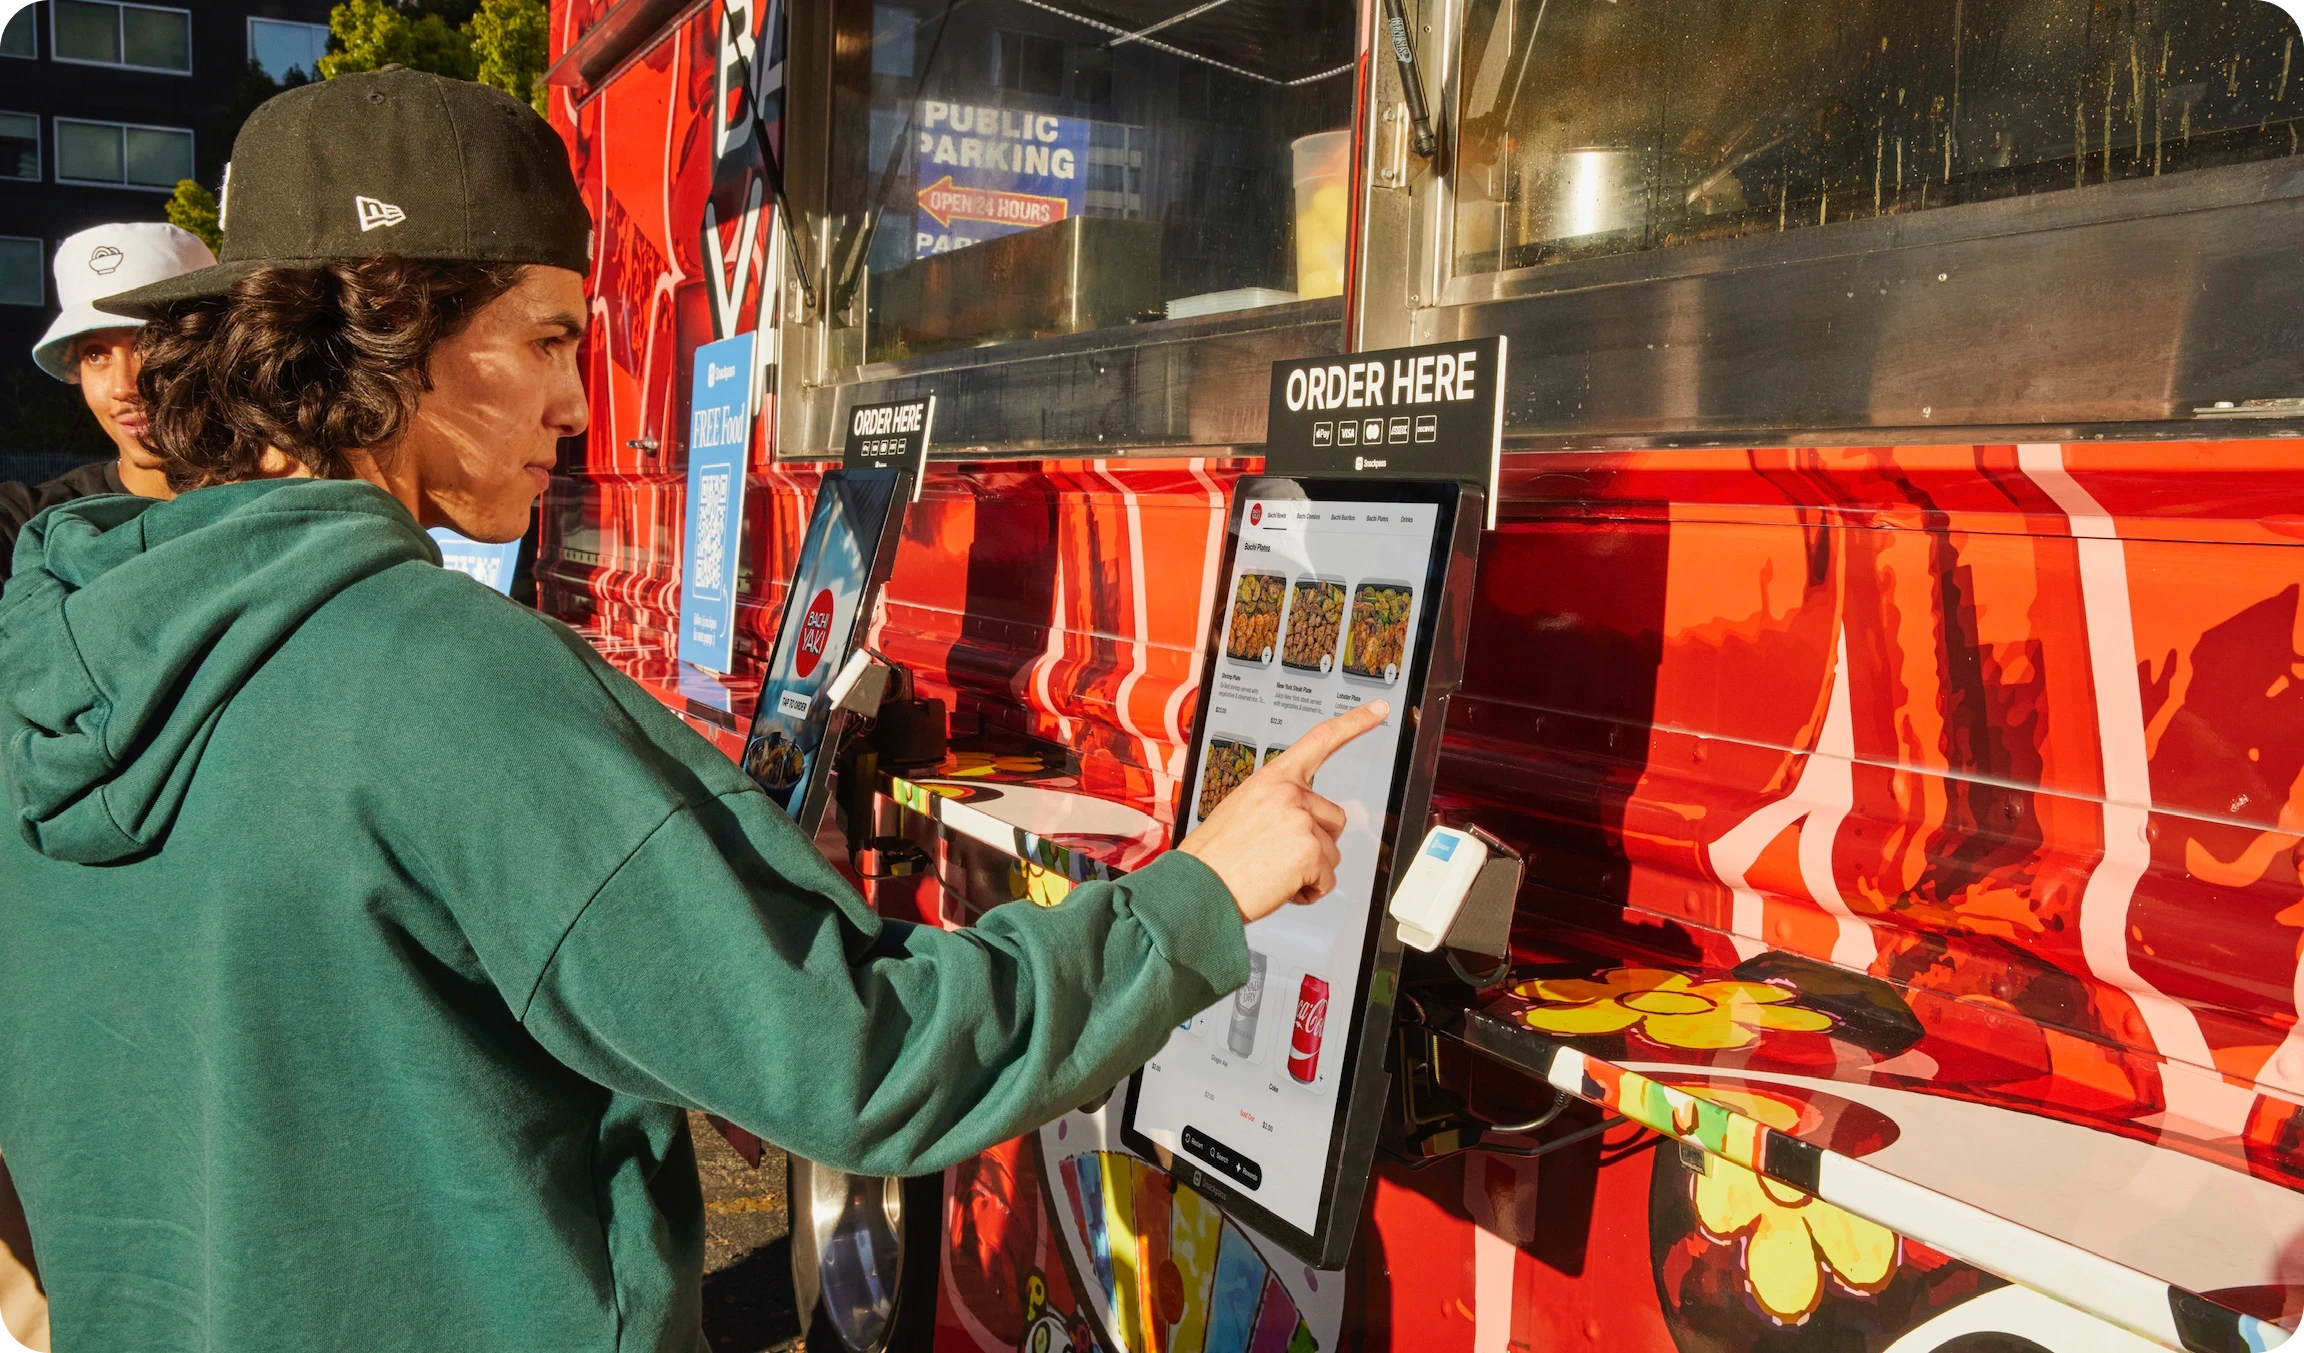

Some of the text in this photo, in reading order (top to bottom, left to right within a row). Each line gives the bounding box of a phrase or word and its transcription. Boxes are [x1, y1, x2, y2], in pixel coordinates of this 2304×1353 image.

[925, 101, 1058, 143] PUBLIC
[930, 191, 1050, 222] OPEN 24 HOURS
[917, 232, 981, 253] PAR
[1286, 351, 1477, 412] ORDER HERE
[692, 401, 745, 449] FREE Food
[853, 403, 924, 436] ORDER HERE
[1341, 428, 1355, 438] VISA
[1364, 459, 1387, 469] Snackpass
[1244, 542, 1271, 552] Bachi Plates
[807, 611, 830, 629] BACHI
[802, 628, 826, 655] YAKI
[782, 697, 790, 706] TAP
[794, 700, 807, 712] ORDER
[1336, 692, 1361, 702] Lobster Plate
[1243, 992, 1257, 1003] DRY
[1269, 1083, 1279, 1093] Coke
[1240, 1109, 1255, 1123] Sold Out
[1262, 1121, 1274, 1132] $2.00
[1201, 1178, 1227, 1201] Snackpass
